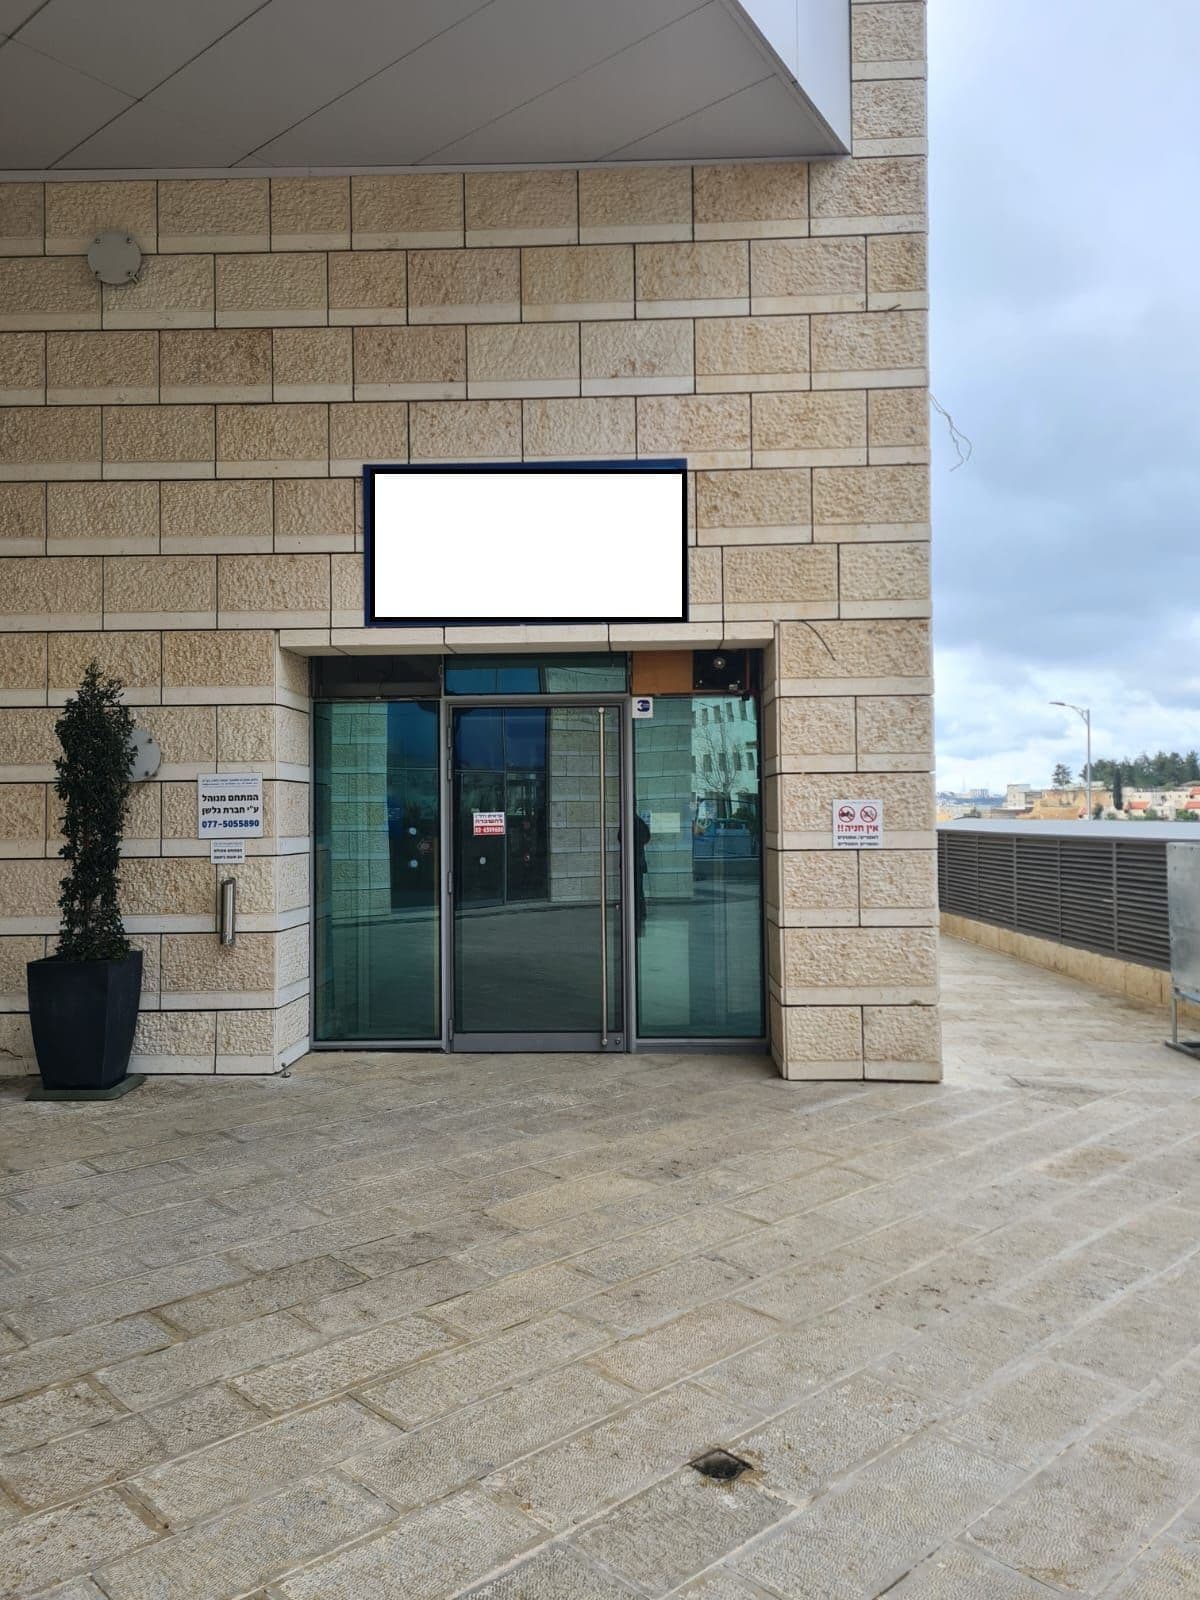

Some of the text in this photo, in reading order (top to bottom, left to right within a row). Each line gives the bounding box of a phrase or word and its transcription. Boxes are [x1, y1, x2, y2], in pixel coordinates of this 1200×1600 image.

[202, 794, 226, 802] מנוהל
[202, 805, 259, 815] ע"י חברת גלשן
[201, 819, 260, 828] 077-5055890
[866, 824, 879, 834] אין
